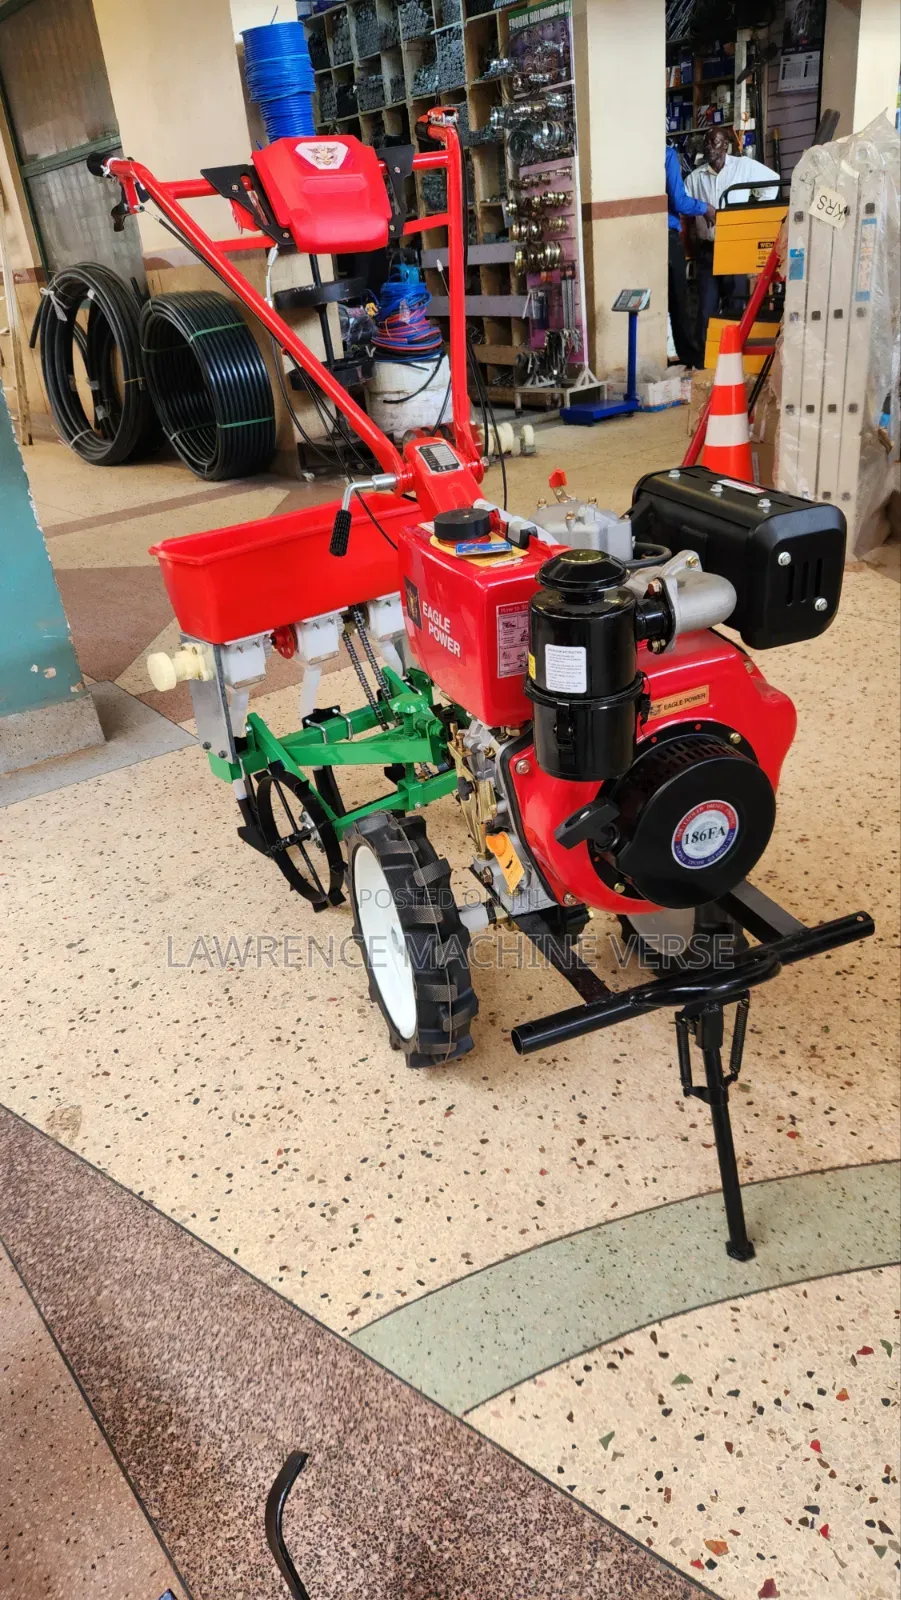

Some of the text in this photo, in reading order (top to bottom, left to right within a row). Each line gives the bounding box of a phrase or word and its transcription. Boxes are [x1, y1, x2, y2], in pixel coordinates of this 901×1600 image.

[422, 600, 451, 634] EAGLE
[428, 621, 461, 658] POWER
[663, 692, 706, 710] EAGLE POWER
[684, 825, 726, 846] 186FA
